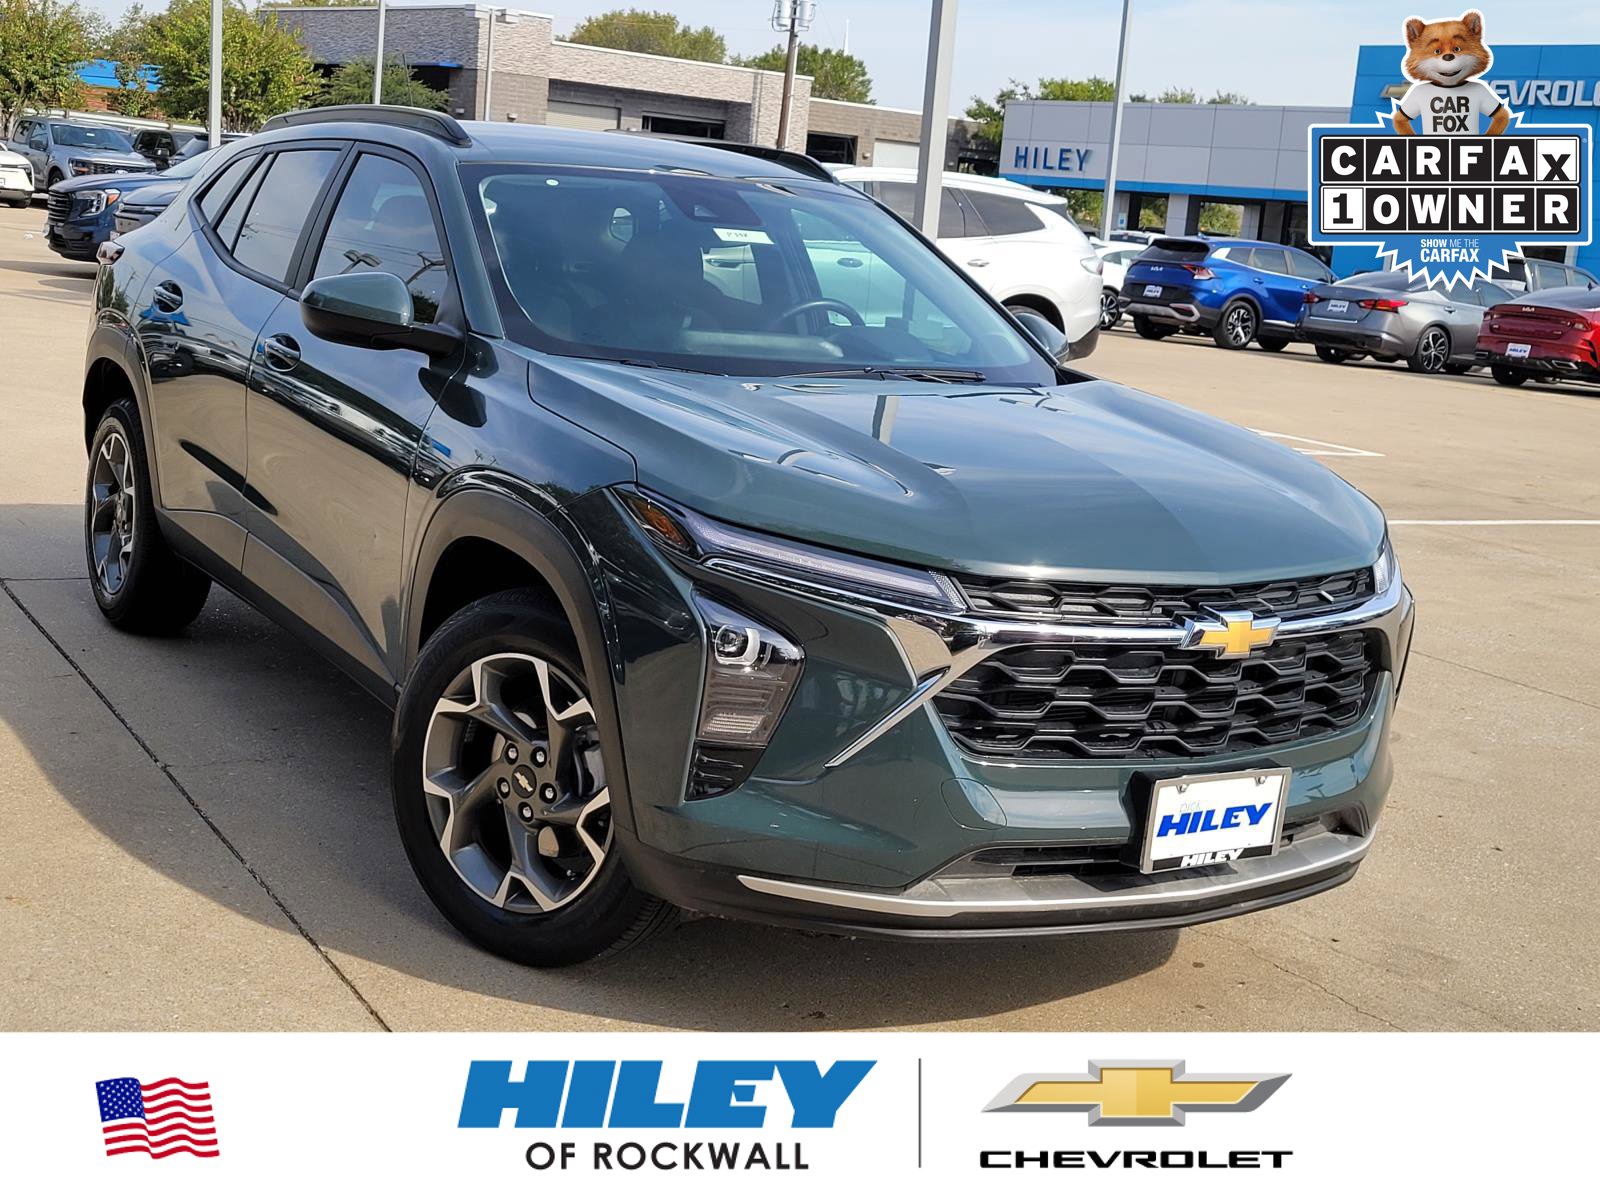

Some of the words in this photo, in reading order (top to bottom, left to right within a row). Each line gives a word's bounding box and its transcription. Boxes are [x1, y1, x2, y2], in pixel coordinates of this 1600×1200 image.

[1488, 79, 1600, 106] EVROL
[1013, 146, 1092, 171] HILEY
[1156, 802, 1273, 838] HILEY
[1180, 847, 1245, 868] HILEY
